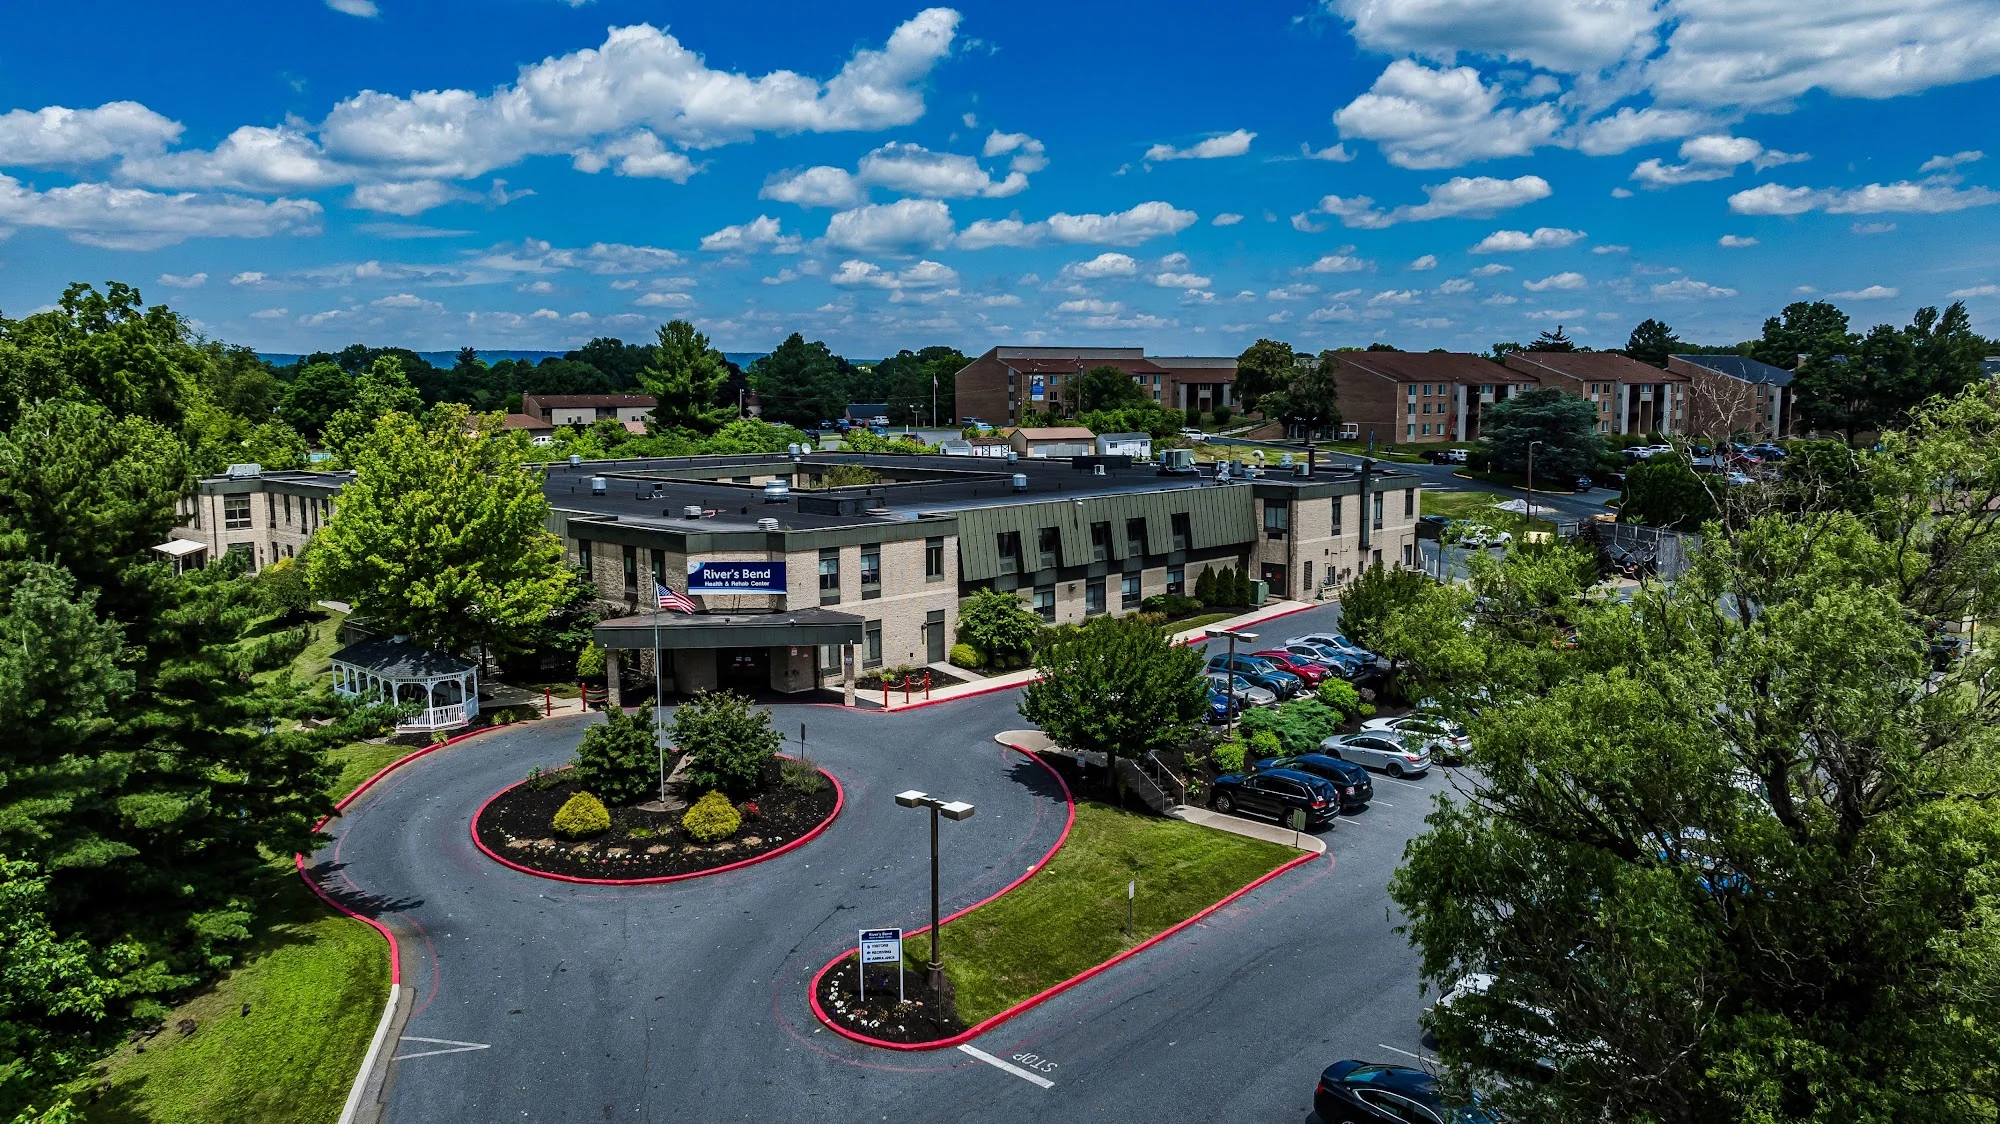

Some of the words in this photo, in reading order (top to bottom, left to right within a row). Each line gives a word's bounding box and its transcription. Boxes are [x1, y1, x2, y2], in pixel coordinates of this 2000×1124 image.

[703, 569, 740, 579] River's
[742, 569, 771, 579] Bend
[1012, 1052, 1058, 1073] STOP
